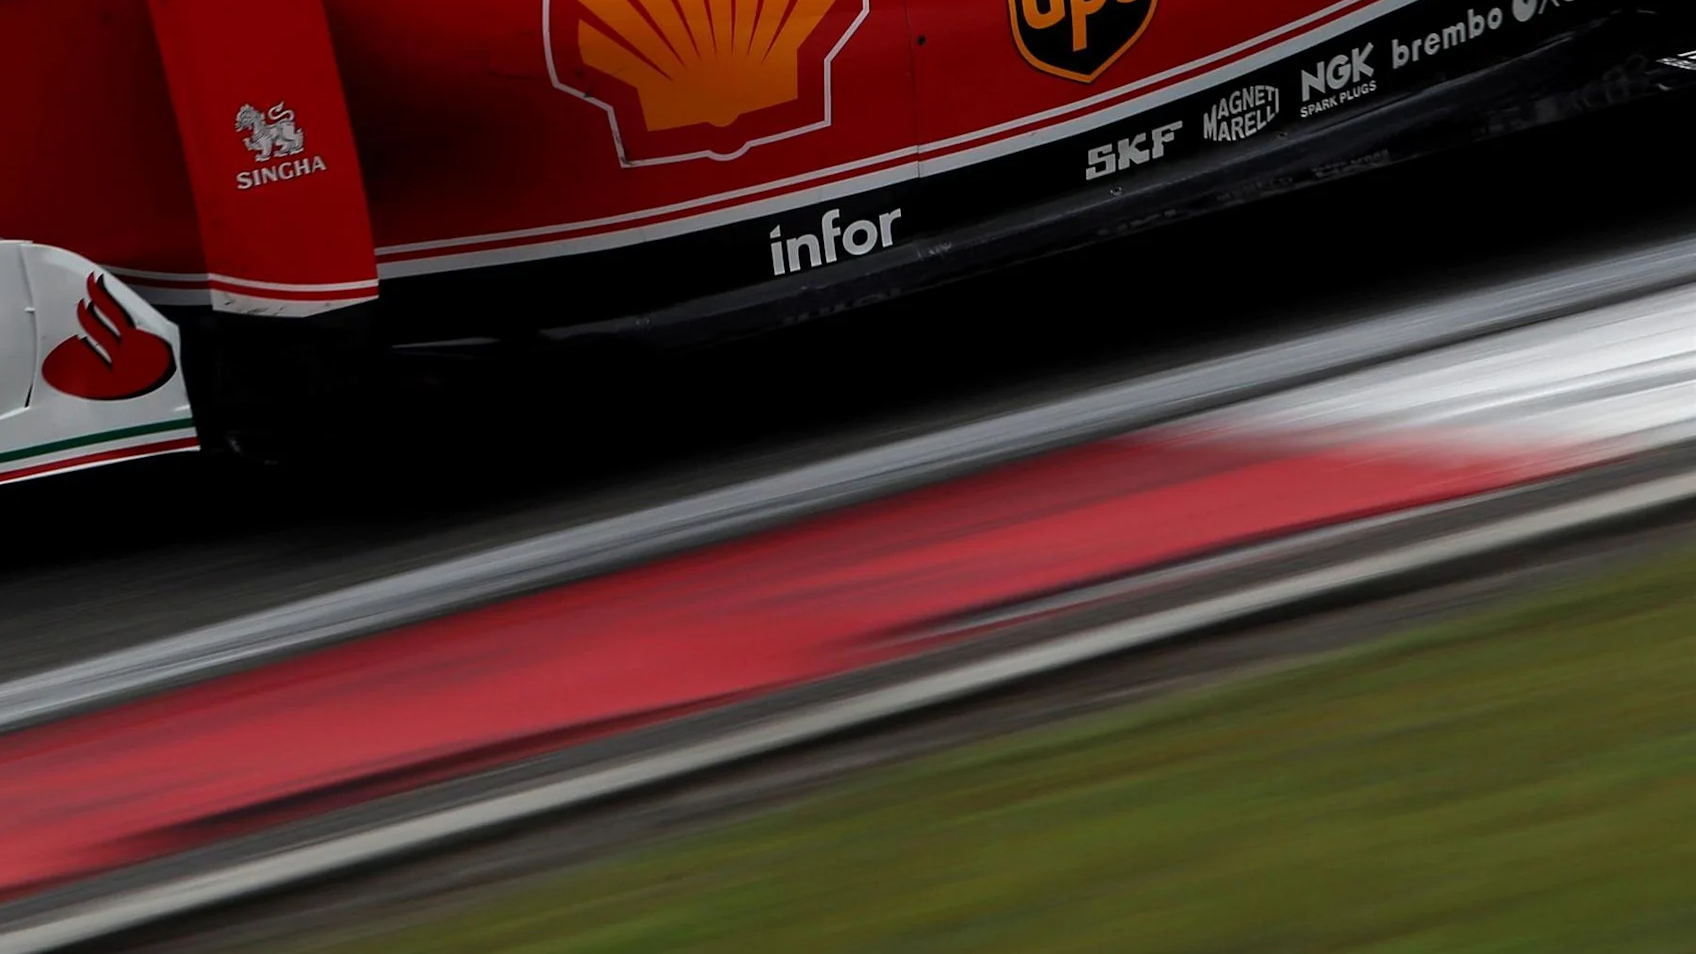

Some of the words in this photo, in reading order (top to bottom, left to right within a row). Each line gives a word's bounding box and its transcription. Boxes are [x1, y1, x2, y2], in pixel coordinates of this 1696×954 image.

[1391, 7, 1504, 61] brembo
[1300, 42, 1375, 102] NGK
[1300, 95, 1338, 119] SPARK
[1339, 79, 1378, 104] PLUGS
[236, 155, 328, 190] SINGHA
[1085, 119, 1183, 181] SKF
[769, 207, 902, 276] infor
